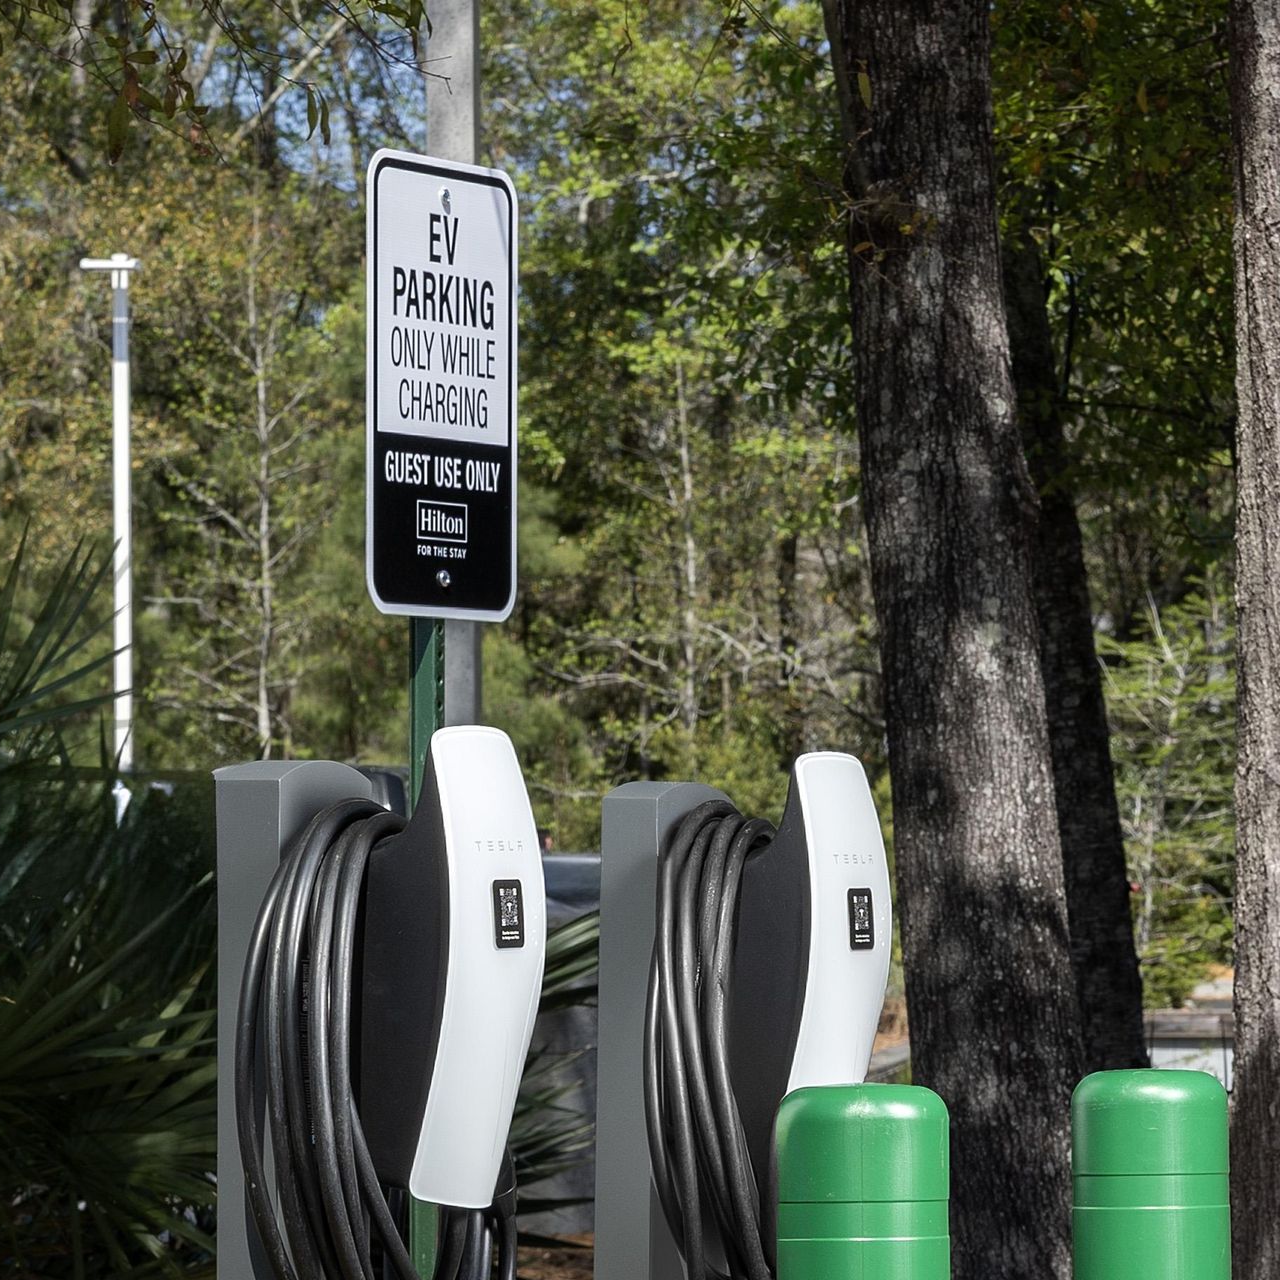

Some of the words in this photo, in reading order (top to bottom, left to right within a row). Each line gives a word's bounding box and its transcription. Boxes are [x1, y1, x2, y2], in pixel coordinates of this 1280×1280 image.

[429, 213, 459, 266] EV
[393, 266, 494, 330] PARKING
[391, 326, 435, 371] ONLY
[440, 333, 496, 379] WHILE
[399, 378, 488, 429] CHARGING
[385, 450, 431, 485] GUEST
[434, 456, 462, 488] USE
[465, 459, 500, 492] ONLY
[420, 508, 463, 534] Hilton
[417, 545, 431, 556] FOR
[433, 546, 448, 558] THE
[449, 547, 467, 559] STAY
[475, 840, 523, 852] TESLA
[833, 853, 874, 864] TESLA
